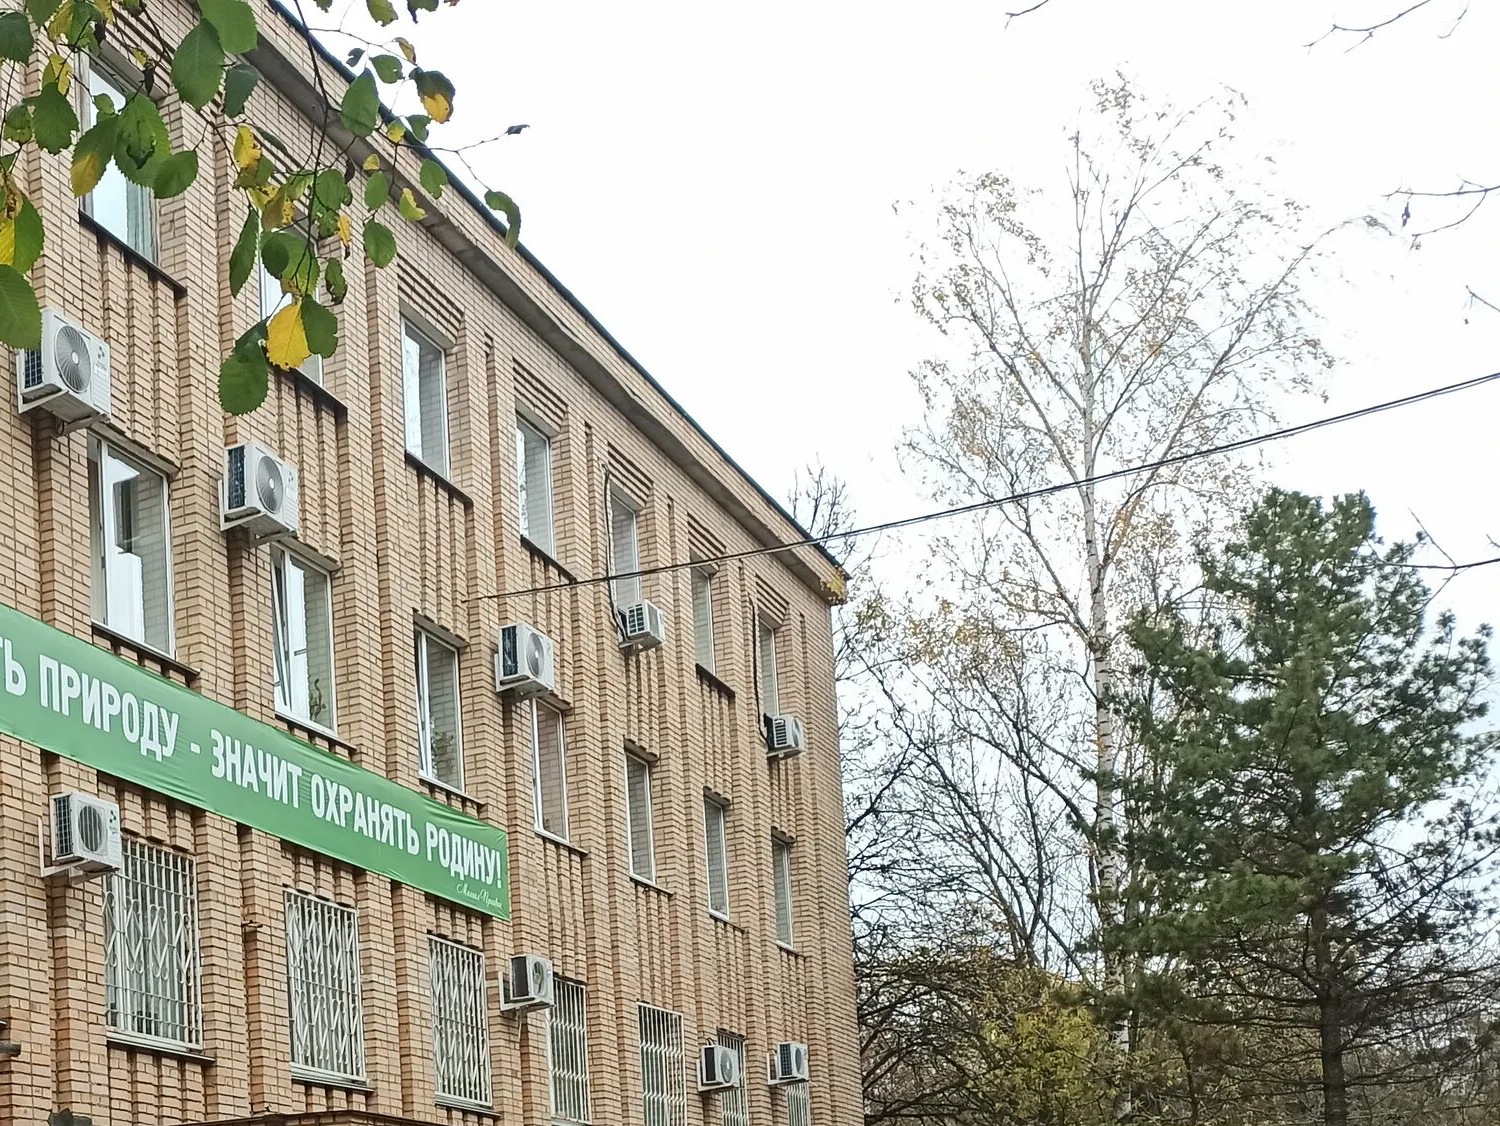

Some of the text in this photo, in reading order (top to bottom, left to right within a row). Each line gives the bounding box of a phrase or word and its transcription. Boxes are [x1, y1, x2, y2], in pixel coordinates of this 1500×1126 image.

[38, 653, 180, 761] ПРИРОДУ
[210, 728, 303, 809] ЗНАЧИТ
[310, 773, 421, 856] ОХРАНЯТЬ
[425, 820, 502, 889] РОДИНУ!
